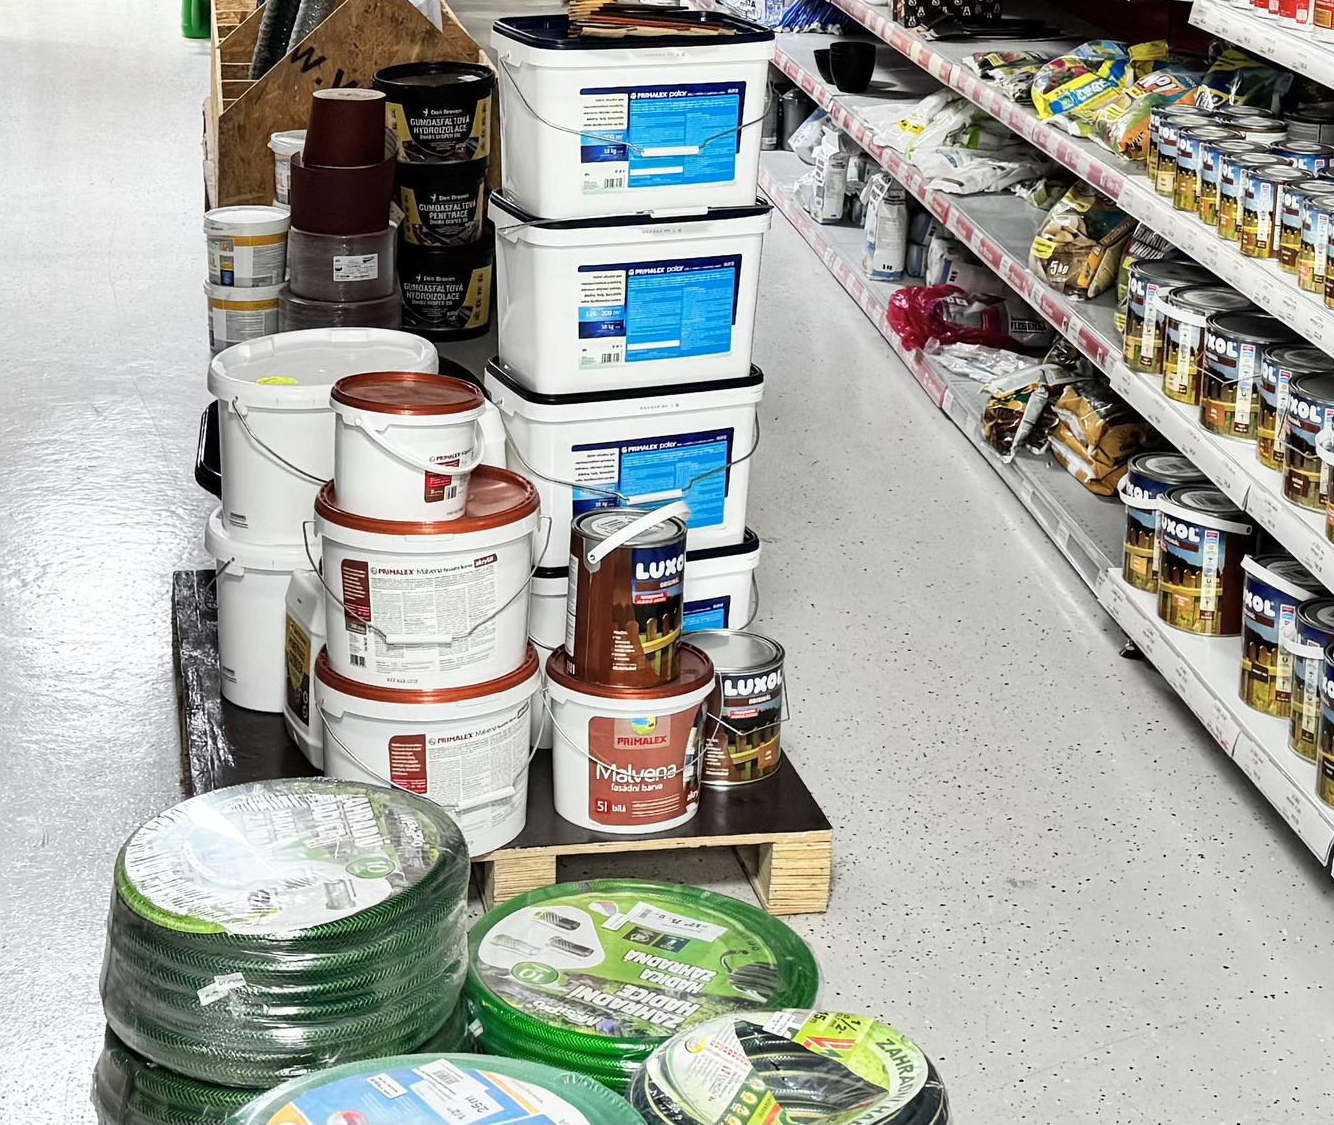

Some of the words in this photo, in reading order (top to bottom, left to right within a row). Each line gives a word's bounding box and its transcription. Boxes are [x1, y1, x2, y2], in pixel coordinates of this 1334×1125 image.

[635, 555, 684, 580] LUXO
[437, 732, 473, 744] PRIMALEX
[617, 736, 667, 746] PRIMALEX
[596, 763, 677, 784] Malvena
[611, 782, 639, 793] fasádní
[641, 782, 664, 792] barva
